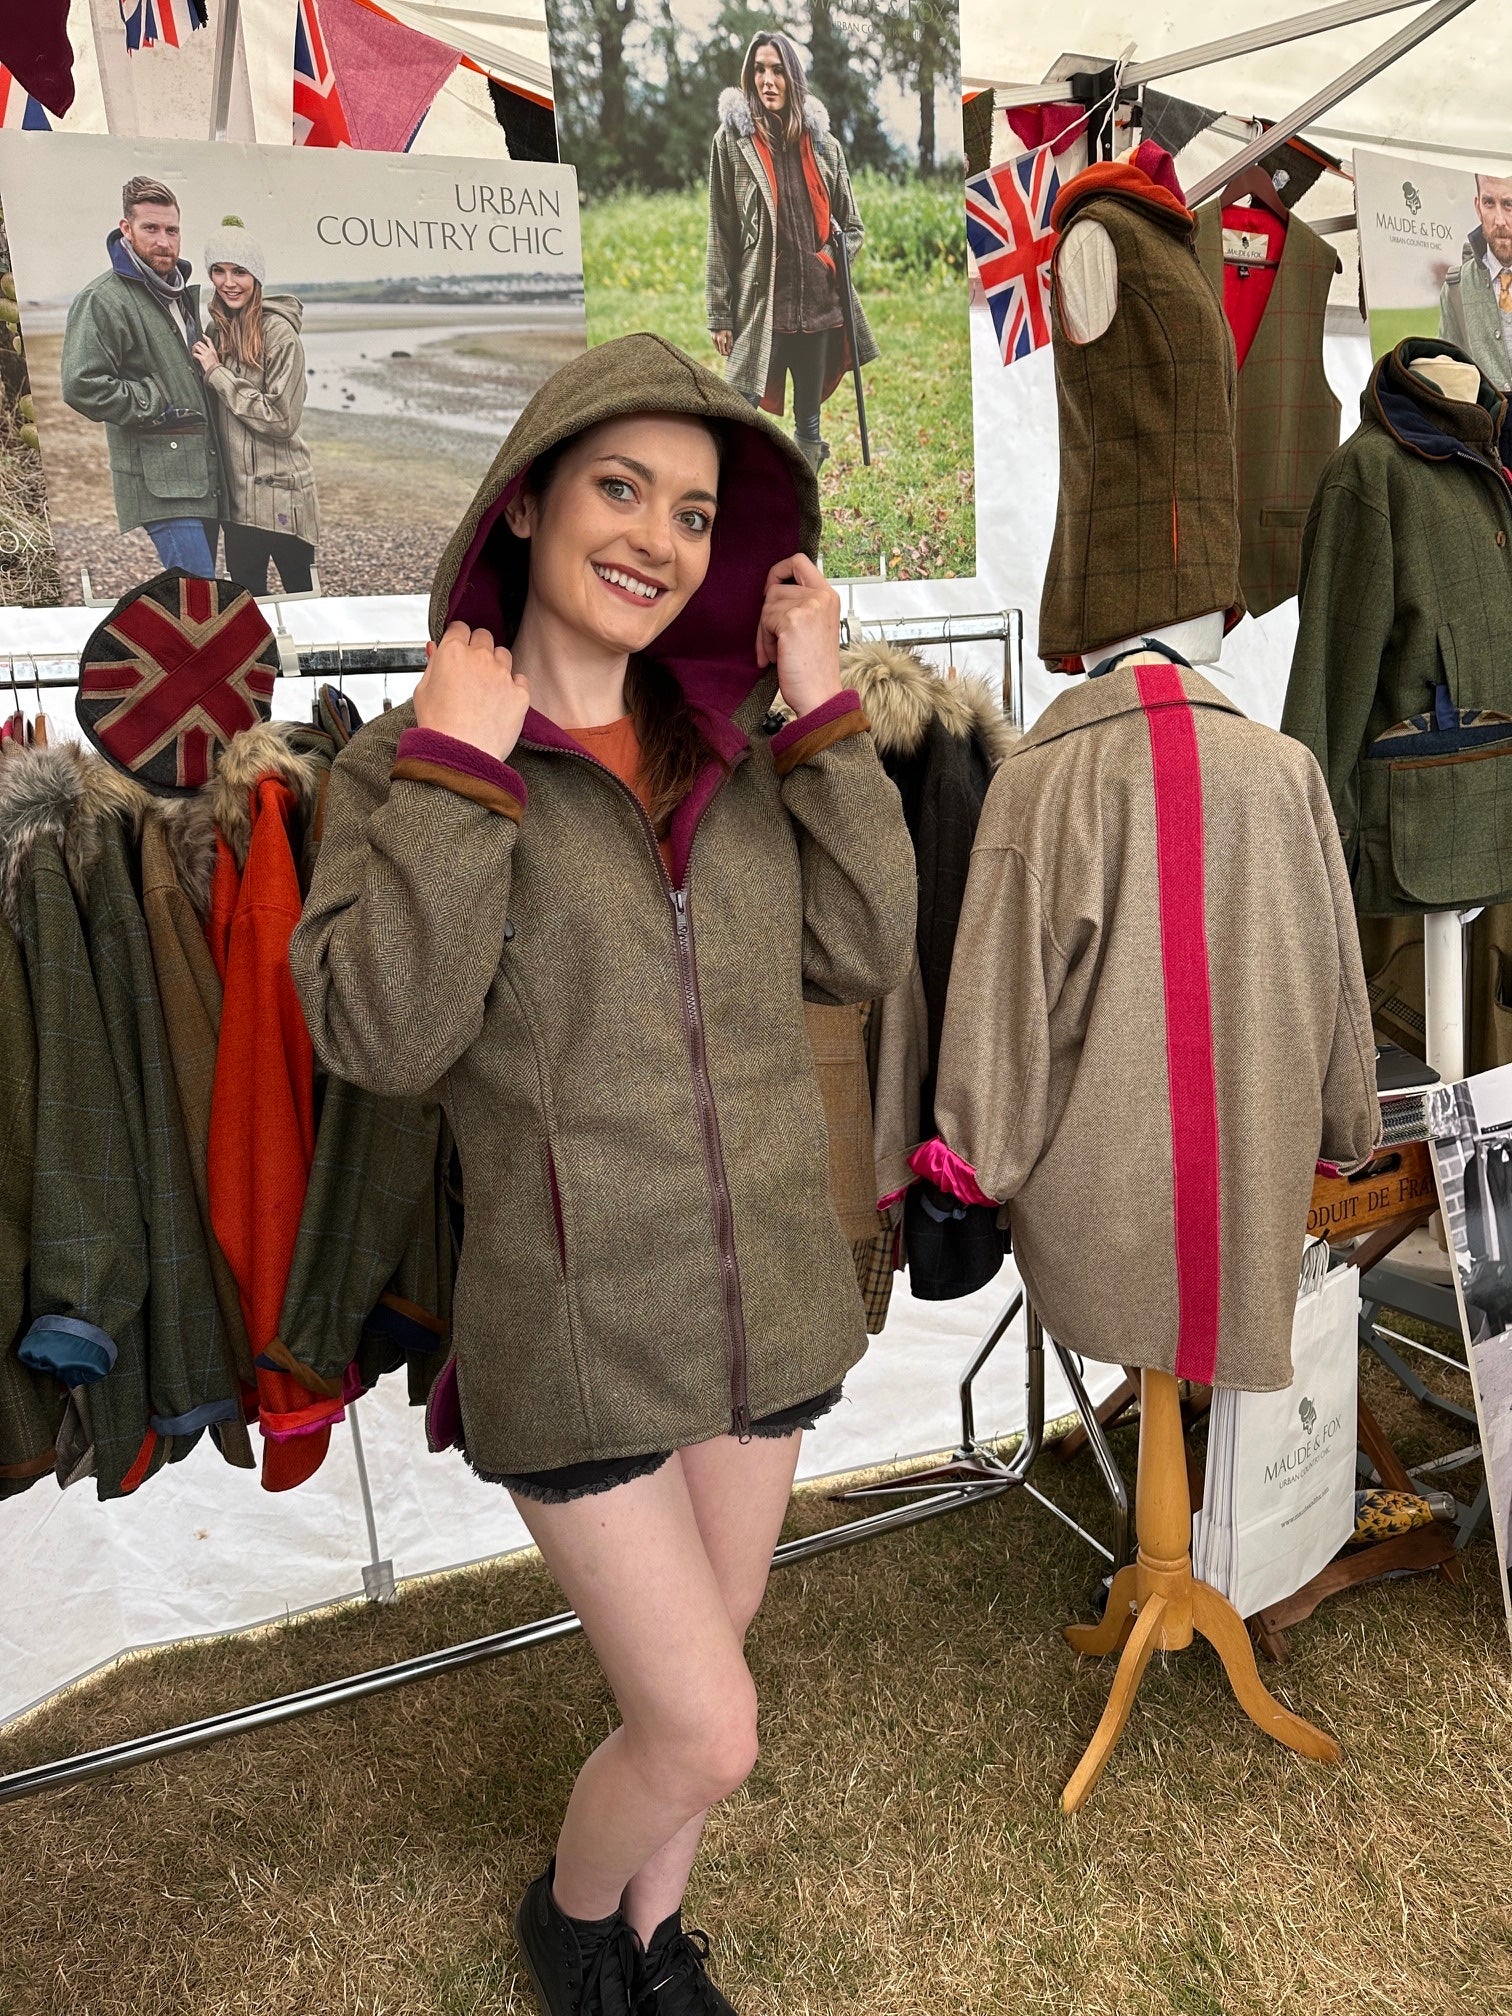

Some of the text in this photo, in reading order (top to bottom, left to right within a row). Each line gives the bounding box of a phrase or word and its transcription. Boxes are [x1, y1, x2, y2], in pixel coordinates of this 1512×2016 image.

[455, 184, 561, 218] URBAN
[316, 215, 564, 256] COUNTRY CHIC
[1376, 212, 1453, 240] MAUDE & FOX
[1367, 1187, 1390, 1212] DE
[1263, 1414, 1342, 1484] MAUDE & FOX
[1279, 1472, 1300, 1489] URBAN
